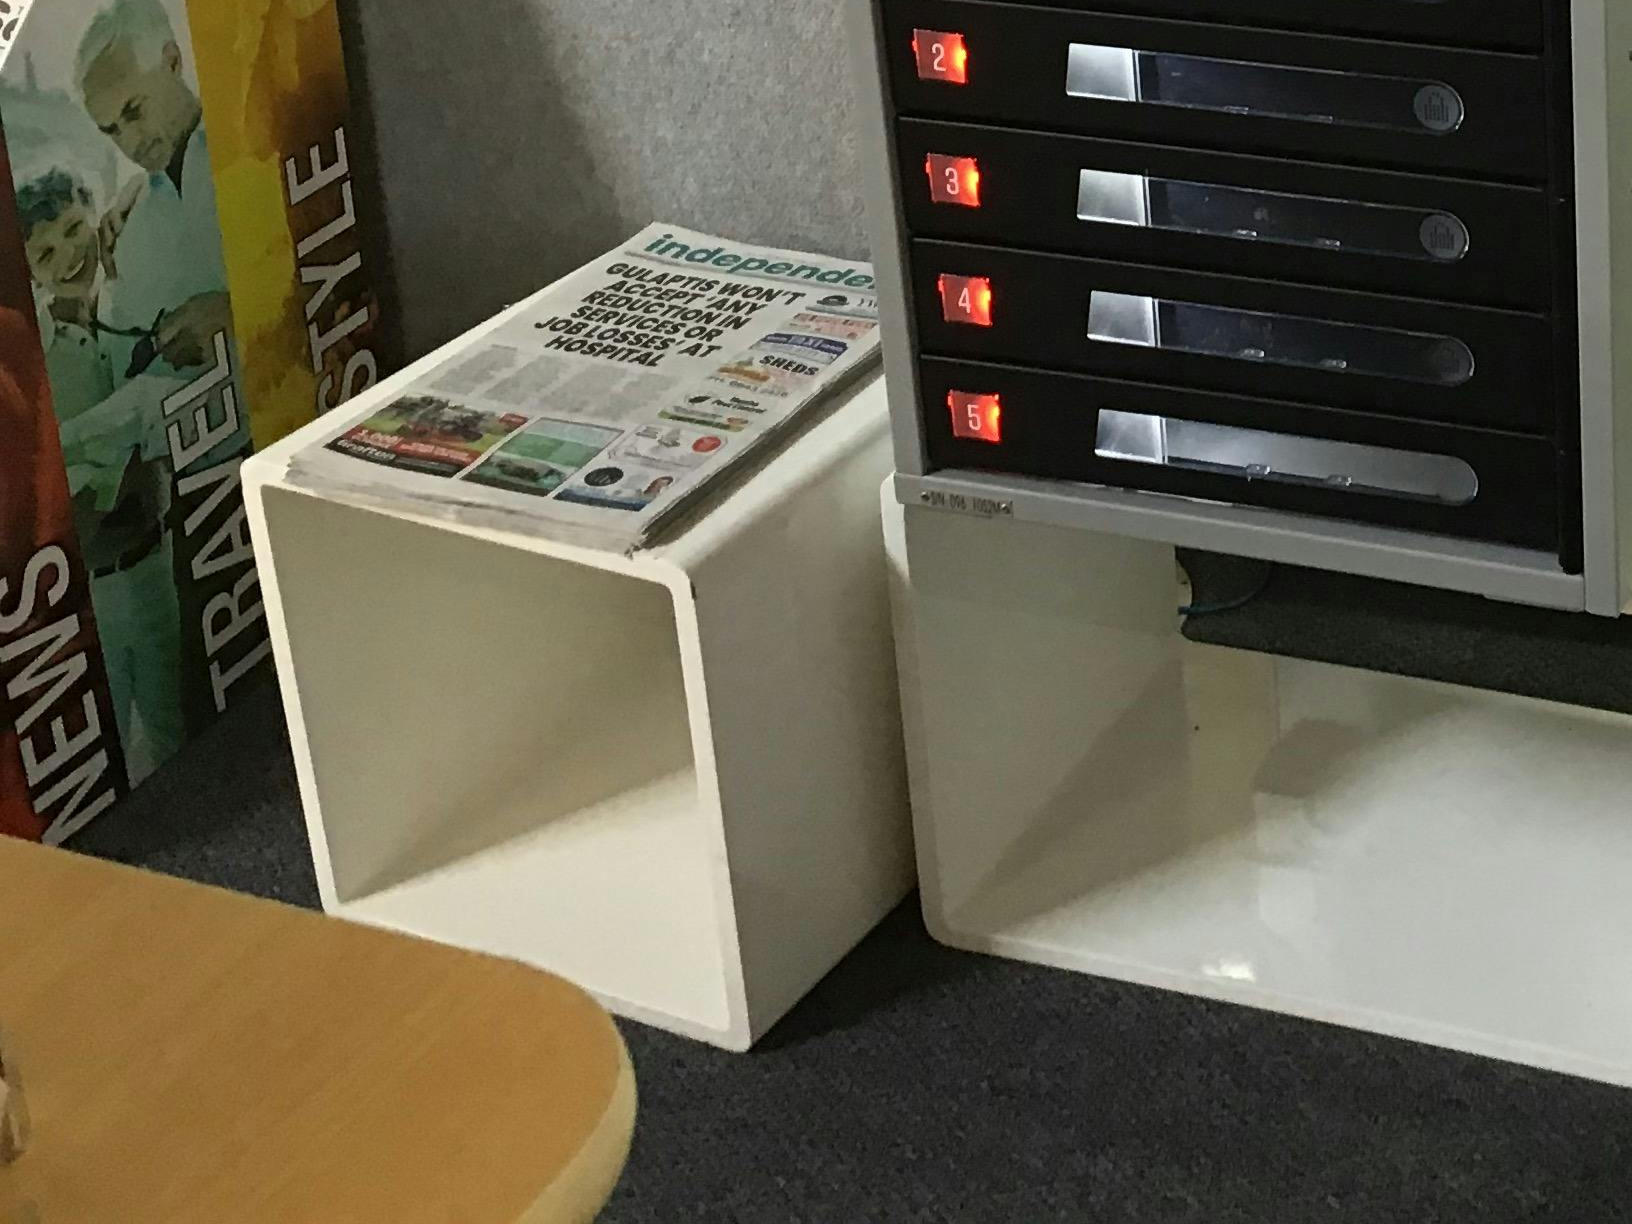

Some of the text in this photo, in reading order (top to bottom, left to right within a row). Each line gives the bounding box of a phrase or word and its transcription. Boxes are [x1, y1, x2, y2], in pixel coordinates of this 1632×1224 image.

[932, 44, 946, 72] 2
[945, 168, 960, 196] 3
[604, 280, 704, 305] ACCEPT
[606, 263, 806, 305] GULAPTIS WON'T
[580, 291, 752, 330] REDUCTION IN
[957, 287, 971, 314] 4
[534, 316, 722, 358] JOB LOSSES' AT
[571, 305, 724, 342] SERVICES OR
[545, 335, 667, 367] HOSPITAL
[759, 355, 819, 376] SHEDS
[967, 404, 982, 431] 5
[160, 330, 269, 714] TRAVEL
[0, 545, 118, 847] NEWS
